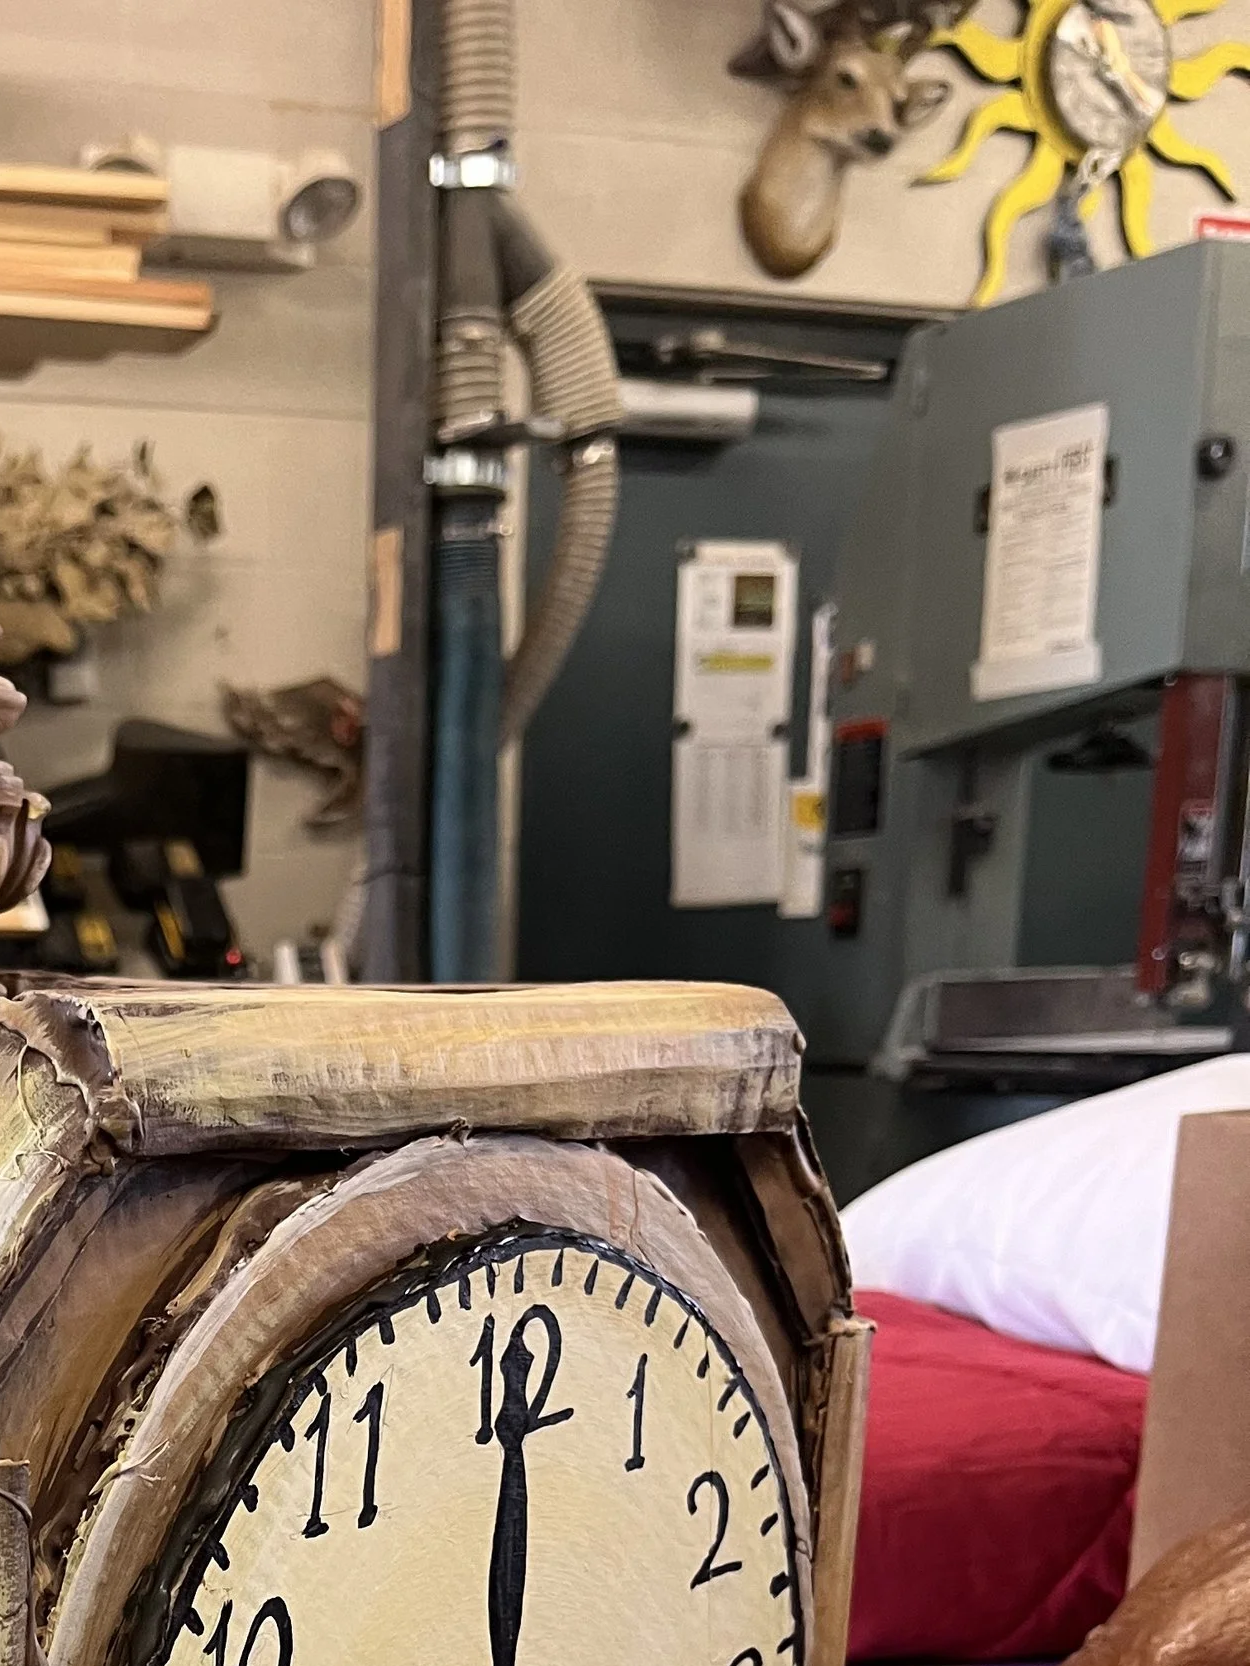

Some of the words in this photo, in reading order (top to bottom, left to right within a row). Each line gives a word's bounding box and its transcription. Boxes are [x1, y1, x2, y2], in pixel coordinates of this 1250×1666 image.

[469, 1303, 574, 1446] 12
[625, 1353, 647, 1472] 1
[302, 1380, 384, 1539] 11
[687, 1470, 742, 1589] 2
